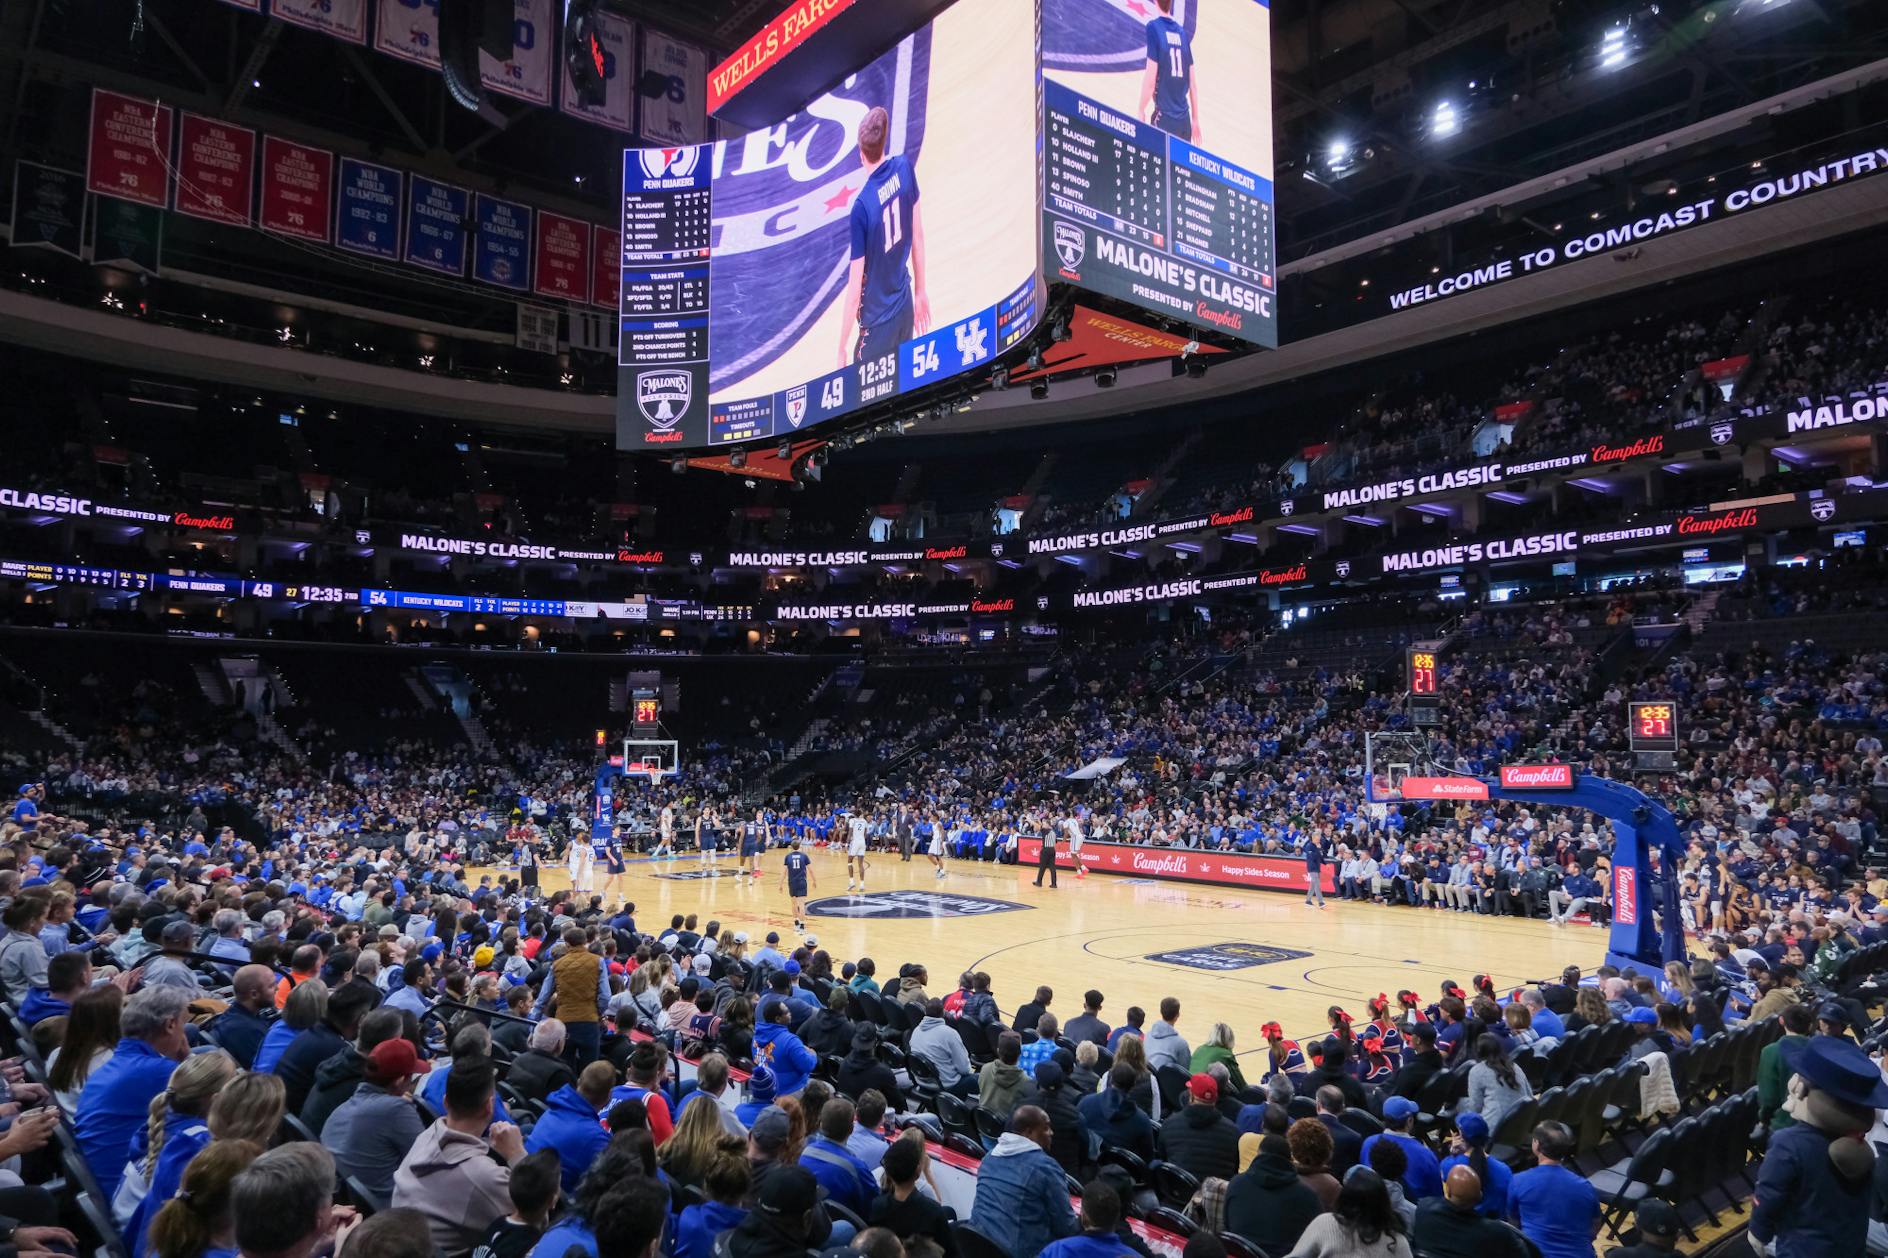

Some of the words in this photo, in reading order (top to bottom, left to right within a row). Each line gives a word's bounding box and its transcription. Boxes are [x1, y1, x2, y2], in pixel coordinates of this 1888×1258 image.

[410, 28, 430, 47] 76
[504, 62, 522, 79] 76
[712, 31, 779, 98] WELLS
[1051, 111, 1069, 125] PLAYER
[1078, 100, 1097, 121] PENN
[1100, 110, 1136, 138] QUAKERS
[1052, 138, 1059, 146] 10
[1063, 142, 1091, 160] HOLLAND
[1063, 157, 1086, 172] BROWN
[1189, 152, 1220, 175] KENTUCKY
[1222, 166, 1255, 191] WILDCATS
[119, 172, 138, 187] 76
[361, 169, 378, 179] NBA
[644, 180, 661, 189] PENN
[662, 177, 694, 188] QUAKERS
[1063, 172, 1090, 188] SPINOSO
[356, 178, 384, 192] WORLD
[432, 187, 448, 199] NBA
[877, 173, 900, 205] BROWN
[1051, 182, 1060, 191] 40
[1063, 186, 1083, 200] SMITH
[346, 187, 394, 206] CHAMPIONS
[426, 196, 452, 210] WORLD
[416, 203, 460, 224] CHAMPIONS
[496, 205, 511, 216] NBA
[1055, 198, 1073, 211] TEAM
[1074, 205, 1097, 220] TOTALS
[288, 212, 304, 225] 76
[492, 214, 516, 227] WORLD
[883, 196, 902, 253] 11
[482, 222, 525, 240] CHAMPIONS
[1179, 245, 1195, 256] TEAM
[1390, 260, 1513, 310] WELCOME
[1520, 248, 1555, 271] TO
[1565, 199, 1716, 259] COMCAST
[555, 278, 568, 288] 76
[1096, 235, 1196, 292] MALONE'S
[1200, 274, 1270, 318] CLASSIC
[1133, 284, 1180, 308] PRESENTED
[1183, 300, 1193, 312] BY
[1196, 300, 1242, 330] Campbell's
[1087, 318, 1141, 338] WELLS
[1105, 331, 1152, 349] CENTER
[913, 341, 939, 378] 54
[859, 353, 896, 386] 12:35
[821, 376, 843, 410] 49
[862, 388, 875, 402] 2ND
[876, 382, 894, 396] HALF
[728, 403, 742, 412] TEAM
[645, 432, 683, 443] Campbell's
[1324, 479, 1415, 510] MALONE'S
[1419, 463, 1501, 493] CLASSIC
[1506, 456, 1569, 476] PRESENTED
[1572, 454, 1587, 466] BY
[1591, 435, 1663, 463] Campbell's
[0, 489, 91, 516] CLASSIC
[96, 505, 155, 521] PRESENTED
[157, 514, 171, 522] BY
[174, 512, 233, 529] Campbell's
[1029, 533, 1098, 553] MALONE'S
[1101, 524, 1156, 545] CLASSIC
[1158, 520, 1197, 533] PRESENTED
[1198, 518, 1208, 528] BY
[1210, 507, 1253, 528] Campbell's
[402, 534, 486, 557] MALONE'S
[489, 543, 555, 560] CLASSIC
[558, 550, 603, 560] PRESENTED
[617, 550, 663, 564] Campbell's
[1383, 544, 1482, 573] MALONE'S
[1486, 532, 1577, 559] CLASSIC
[1583, 528, 1653, 545] PRESENTED
[1655, 524, 1672, 536] BY
[1677, 508, 1757, 536] Campbell's
[729, 552, 804, 566] MALONE'S
[808, 551, 867, 565] CLASSIC
[871, 552, 913, 561] PRESENTED
[914, 552, 923, 560] BY
[925, 546, 966, 561] Campbell's
[2, 562, 26, 570] MARC
[27, 565, 52, 573] PLAYER
[27, 572, 52, 580] POINTS
[170, 580, 188, 590] PENN
[190, 581, 225, 592] QUAKERS
[253, 583, 273, 598] 49
[286, 588, 297, 597] 27
[302, 586, 343, 601] 12:35
[345, 592, 359, 600] 2ND
[370, 591, 387, 605] 54
[1074, 587, 1143, 608] MALONE'S
[1146, 579, 1201, 600] CLASSIC
[1204, 578, 1245, 590] PRESENTED
[1247, 576, 1257, 585] BY
[1260, 564, 1306, 584] Campbell's
[403, 596, 432, 606] KENTUCKY
[434, 598, 464, 608] WILDCATS
[777, 605, 852, 620] MALONE'S
[855, 604, 916, 618] CLASSIC
[918, 605, 960, 613] PRESENTED
[961, 604, 969, 612] BY
[971, 599, 1014, 614] Campbell's
[1414, 655, 1434, 668] 12:35
[1415, 669, 1432, 692] 27
[639, 701, 655, 710] 12:35
[1640, 707, 1670, 719] 12:35
[638, 710, 654, 721] 27
[1644, 720, 1665, 735] 27
[1506, 768, 1566, 783] Campbell's
[792, 859, 800, 869] 11
[1080, 852, 1100, 862] Season
[1133, 852, 1187, 873] Campbell's
[1222, 865, 1243, 877] Happy
[1244, 866, 1262, 877] Sides
[1264, 868, 1289, 879] Season
[1617, 868, 1635, 923] Campbell's
